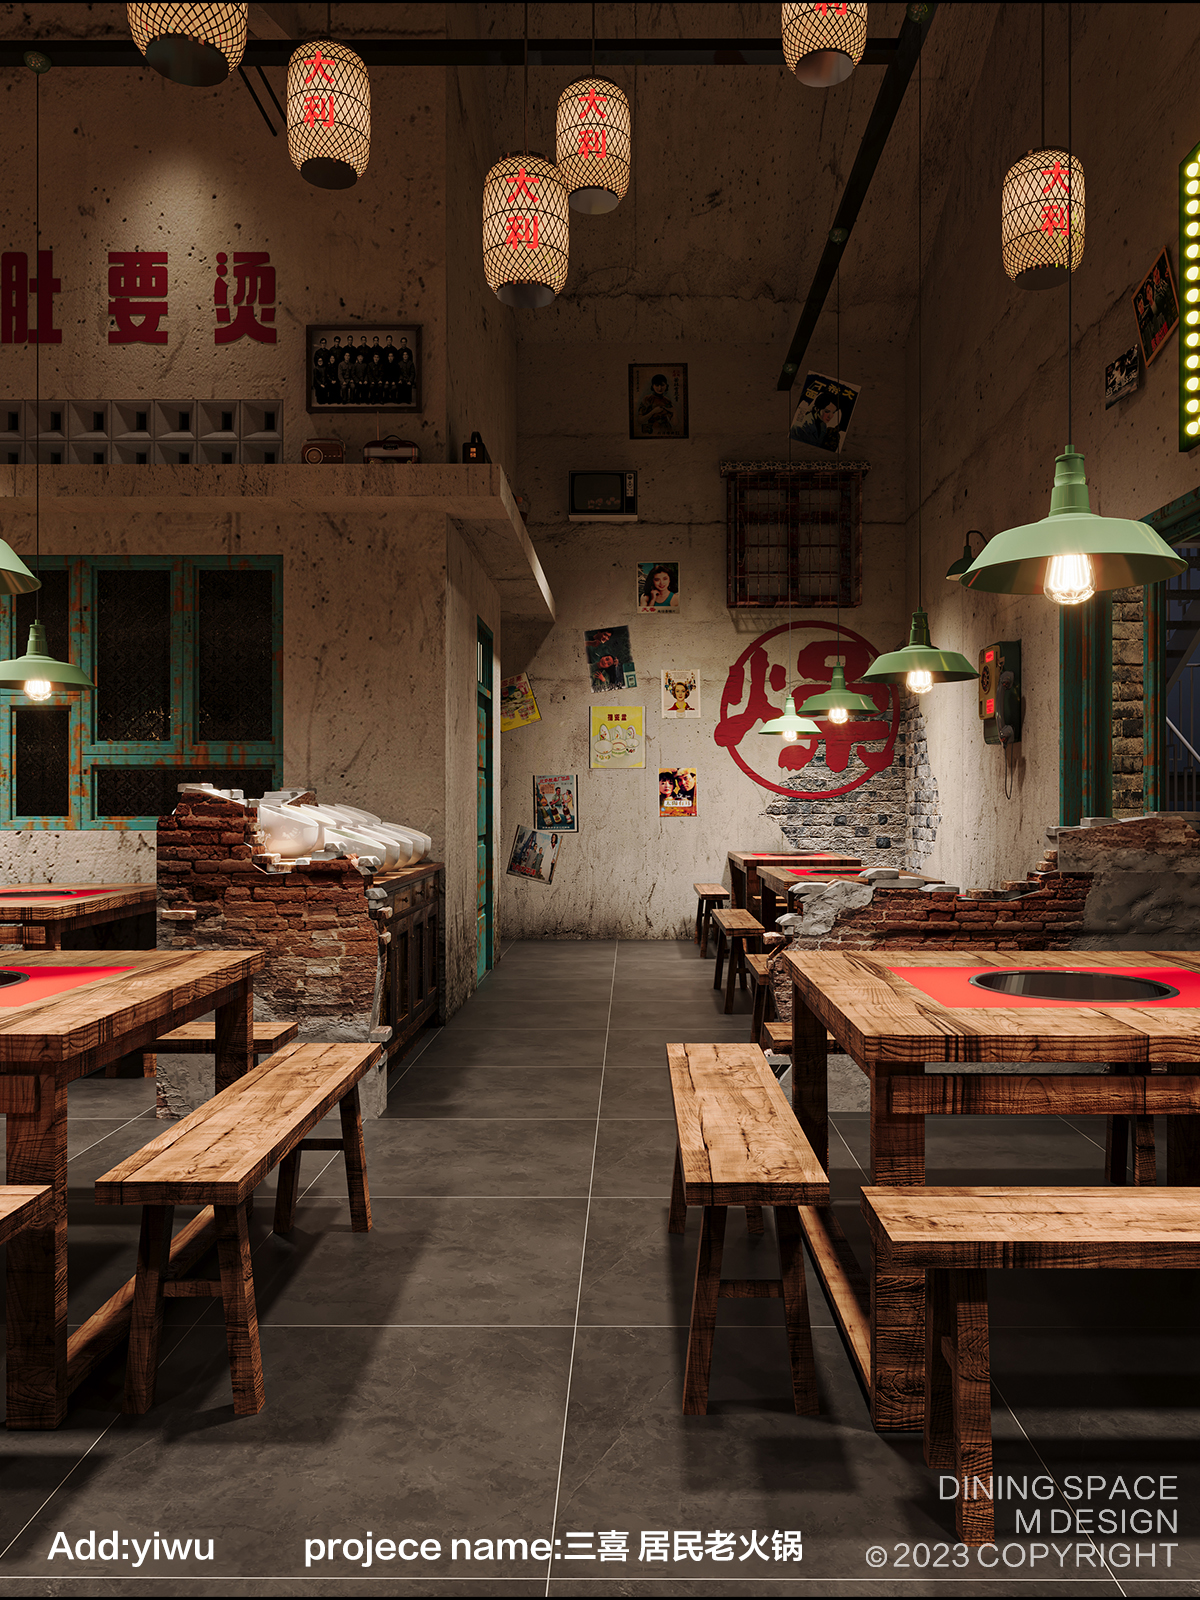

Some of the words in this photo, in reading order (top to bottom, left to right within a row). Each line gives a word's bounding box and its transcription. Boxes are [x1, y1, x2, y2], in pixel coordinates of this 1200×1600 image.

[303, 50, 335, 128] 大利
[578, 88, 608, 160] 大利
[505, 168, 540, 250] 大利
[1041, 161, 1071, 236] 大利
[1, 250, 277, 345] 肚要烫
